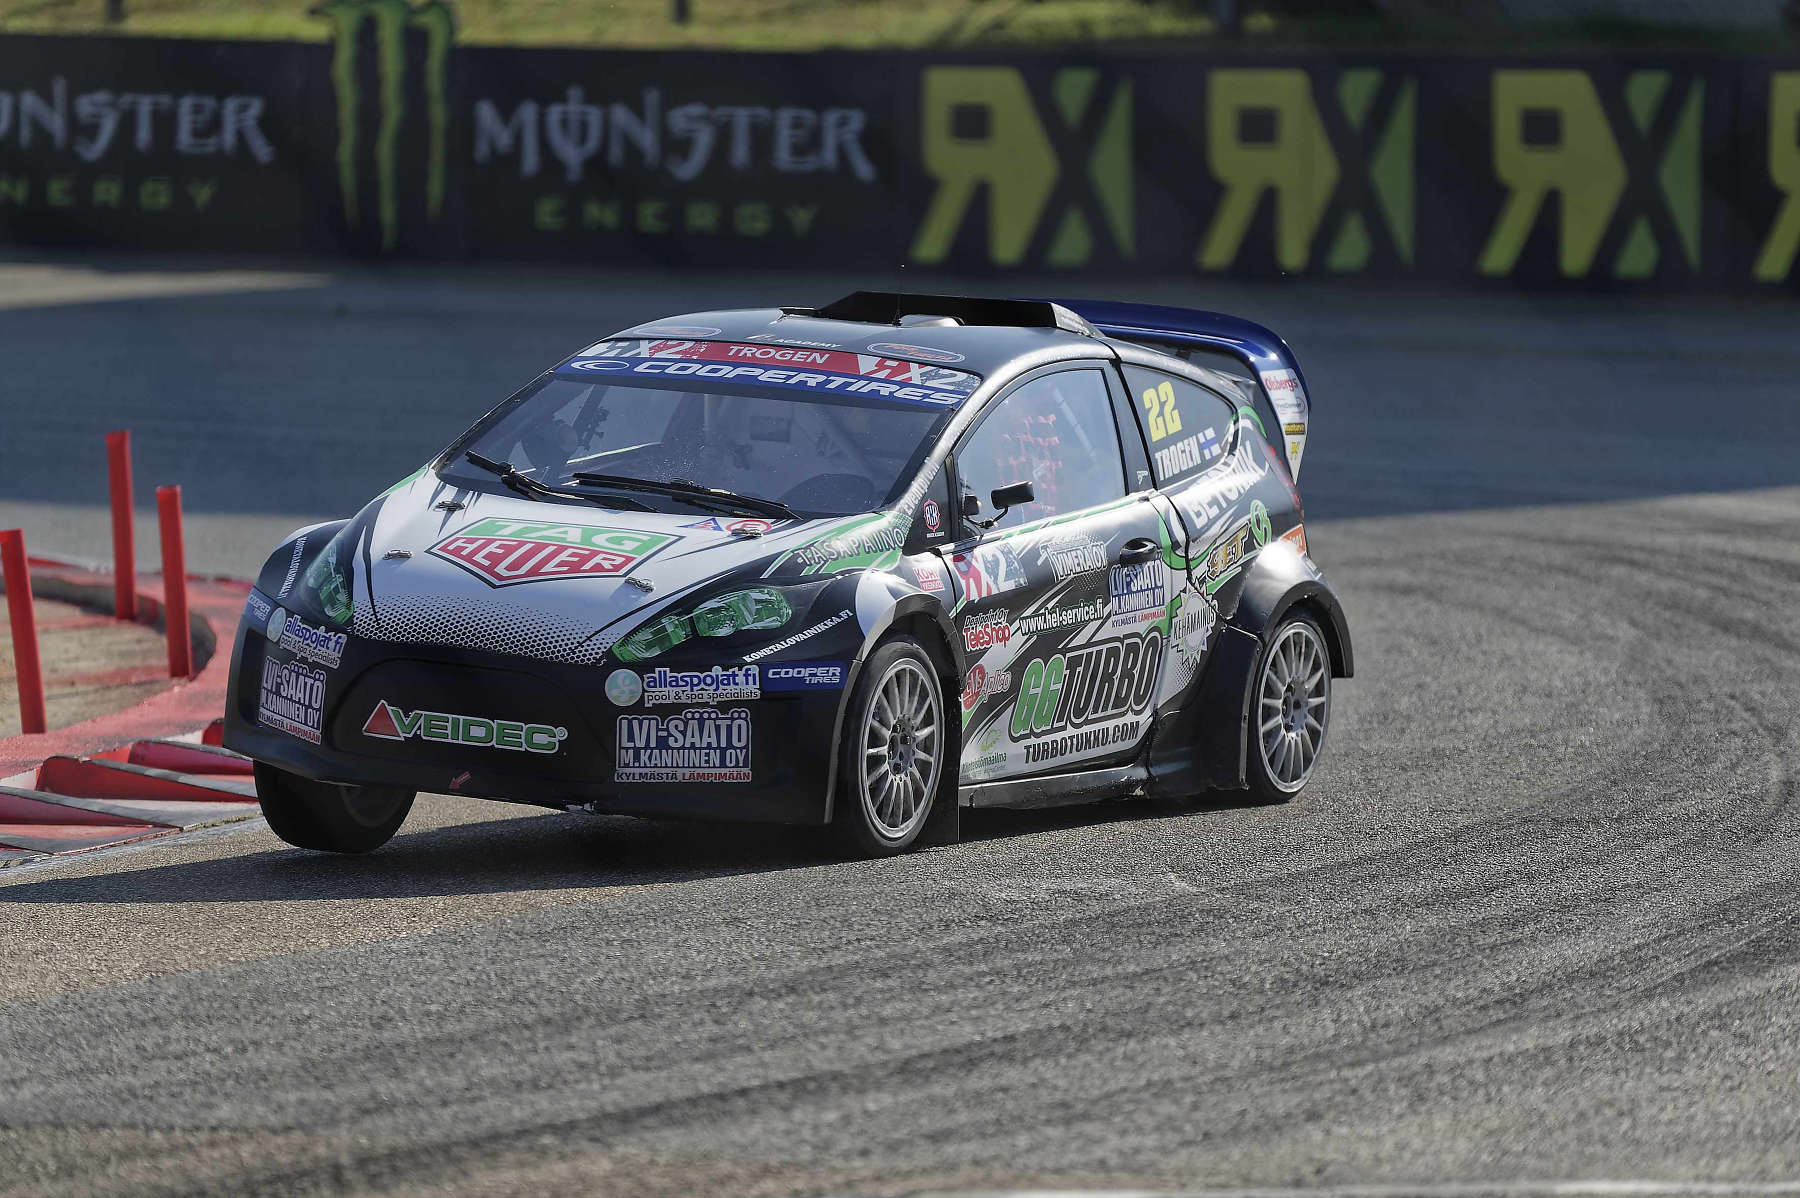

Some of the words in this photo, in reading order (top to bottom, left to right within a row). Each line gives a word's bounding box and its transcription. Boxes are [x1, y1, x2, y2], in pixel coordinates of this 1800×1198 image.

[0, 76, 276, 163] NSTER
[474, 87, 876, 182] MONSTER
[535, 197, 820, 237] ENERGY
[728, 345, 830, 365] TROGEN
[1143, 381, 1182, 442] 22
[1155, 435, 1202, 481] TROGEN
[489, 521, 651, 551] TAG
[447, 537, 621, 577] HEUER
[1154, 587, 1165, 607] OY
[1020, 599, 1103, 634] www.hel-service.fi
[963, 622, 1011, 649] TeleShop
[263, 658, 325, 709] LVI-SÄÄTÖ
[768, 667, 841, 679] COOPER
[803, 676, 840, 684] TIRES
[646, 690, 667, 701] pool
[670, 688, 682, 700] &
[685, 690, 704, 702] spa
[707, 688, 758, 702] specialists
[307, 708, 320, 728] OY
[391, 708, 557, 752] VEIDEC
[621, 712, 748, 748] LVI-SÄÄTÖ
[620, 749, 720, 767] M.KANNINEN
[726, 749, 747, 767] OY
[1024, 721, 1140, 764] TURBOTUKKU.COM
[616, 771, 678, 782] KYLMÄSTÄ
[682, 771, 750, 782] LÄMPIMÄÄN
